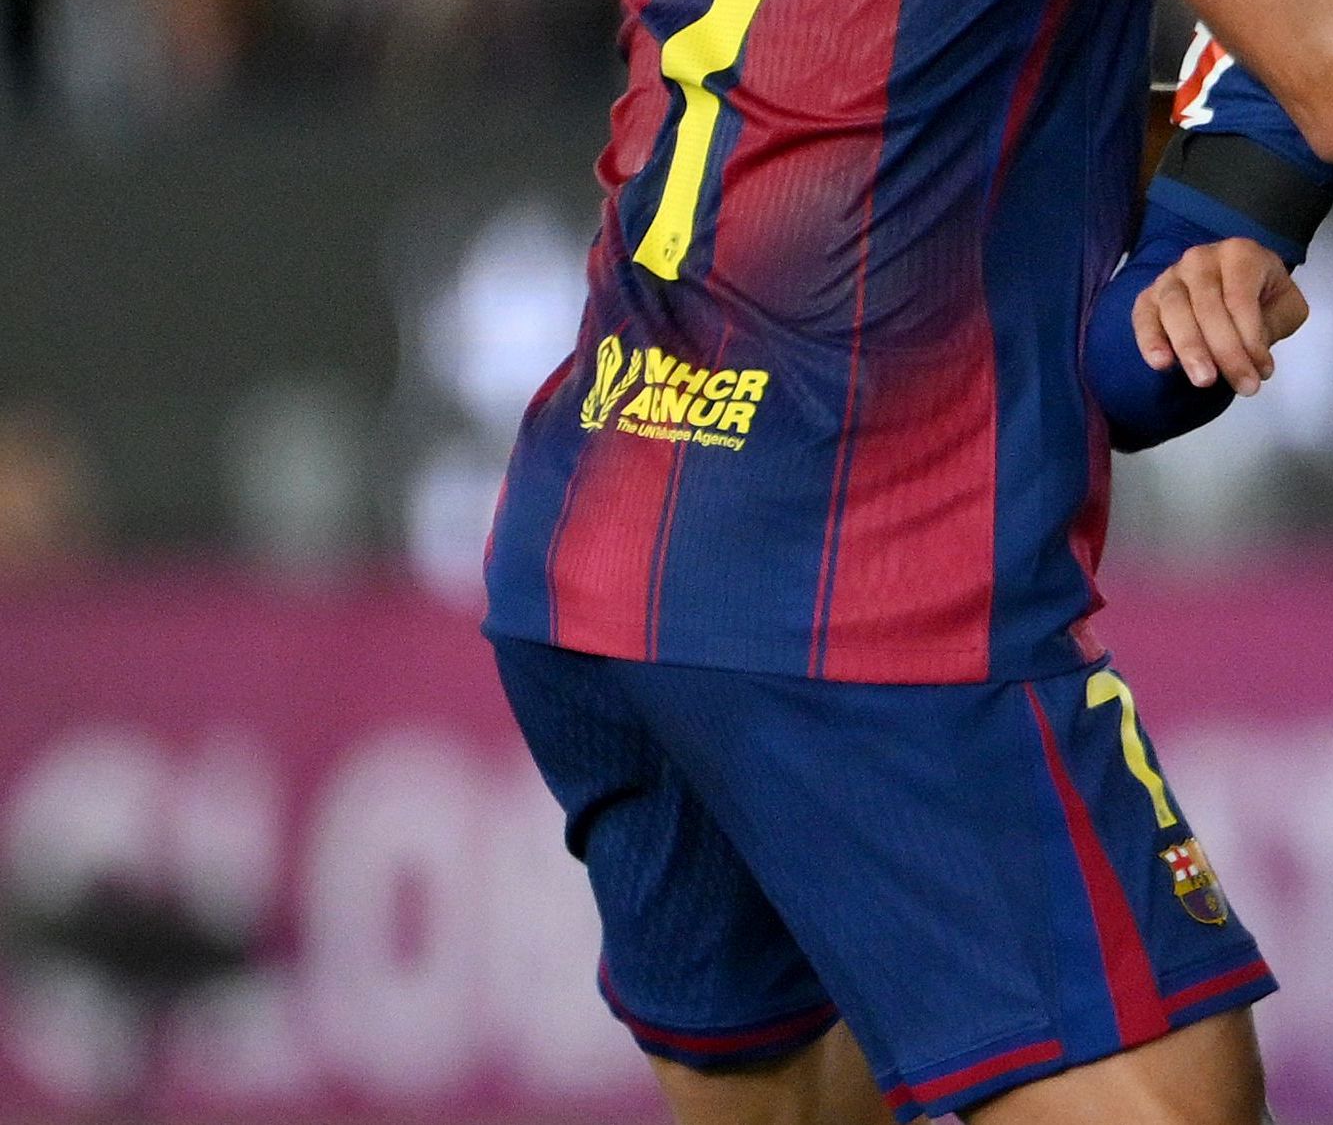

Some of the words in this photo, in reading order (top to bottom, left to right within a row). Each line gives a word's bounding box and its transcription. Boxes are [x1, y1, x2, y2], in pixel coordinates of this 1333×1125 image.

[644, 346, 769, 402] NHCR
[616, 418, 638, 434] The
[692, 429, 746, 452] Agency
[1086, 670, 1178, 829] 7
